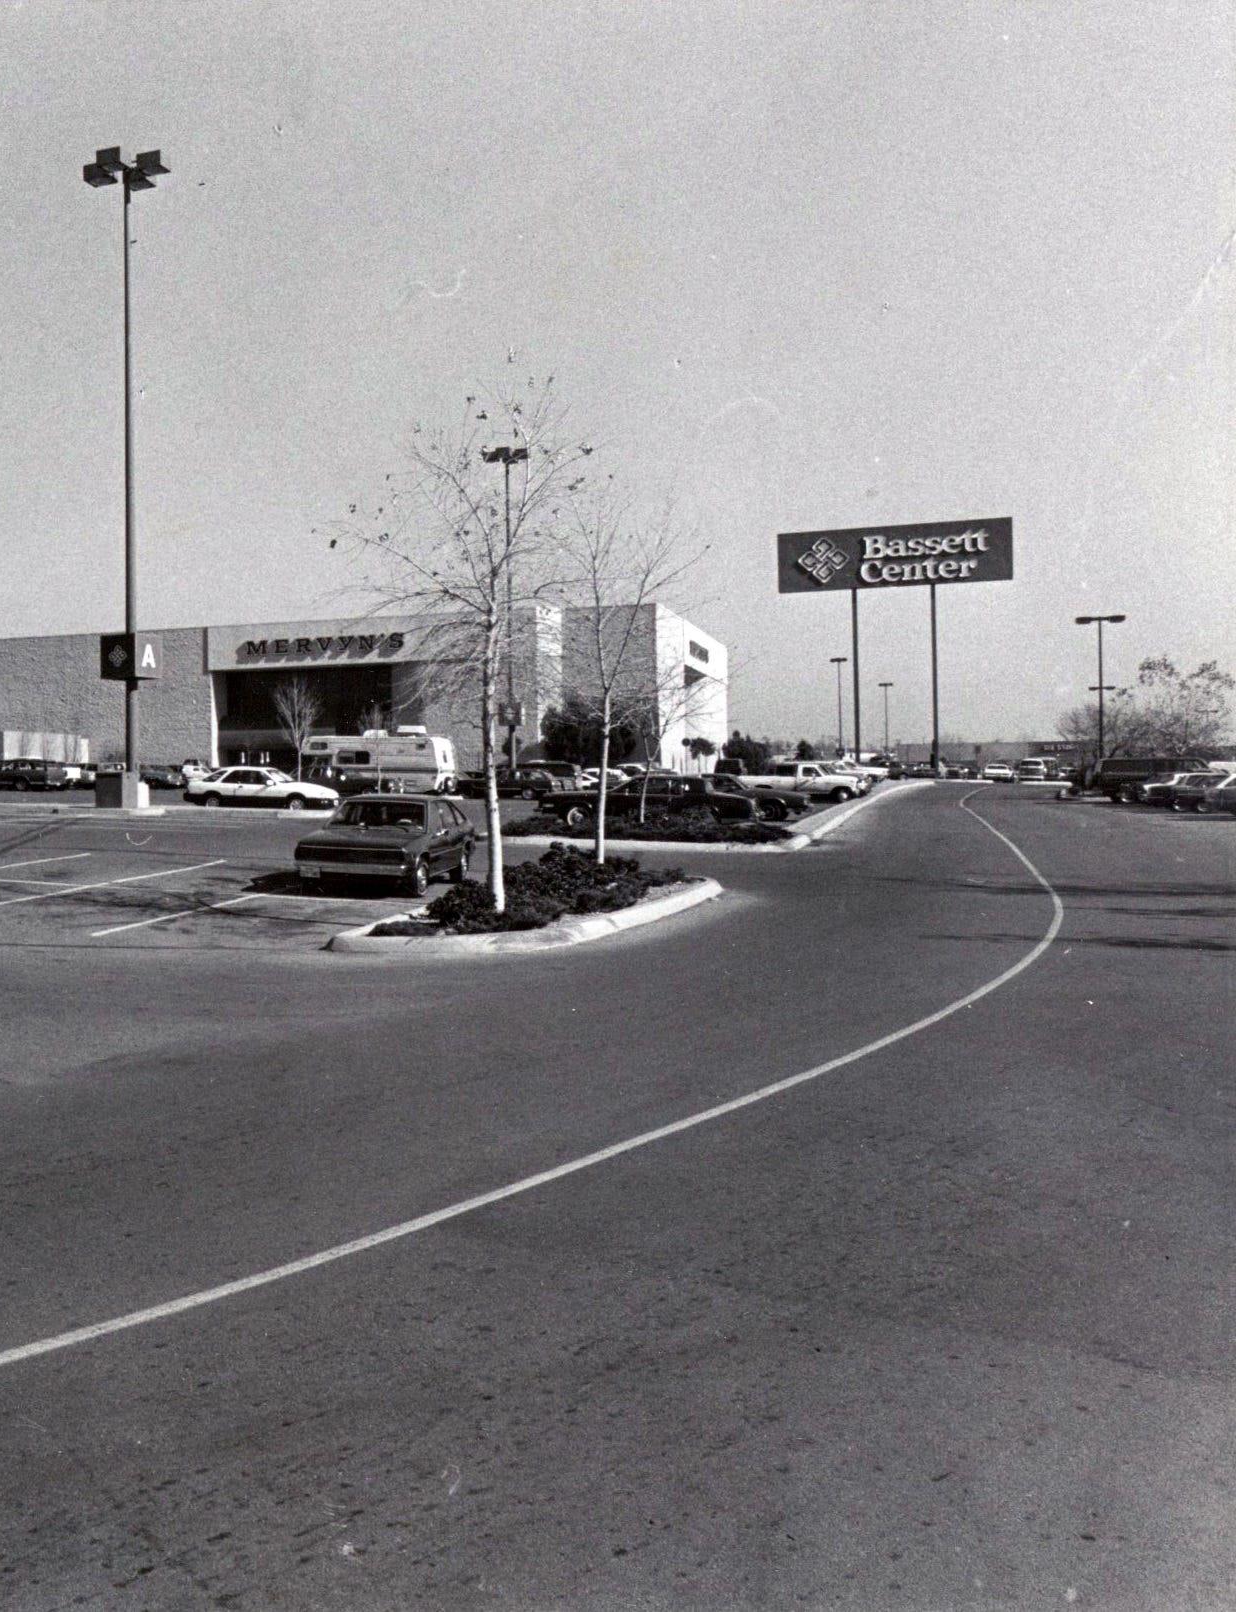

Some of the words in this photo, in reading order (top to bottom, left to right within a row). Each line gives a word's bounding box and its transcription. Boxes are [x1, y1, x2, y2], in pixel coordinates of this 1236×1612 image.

[862, 528, 990, 560] Bassett
[860, 557, 979, 584] Center
[141, 643, 156, 668] A
[246, 632, 404, 655] MERVYN'S
